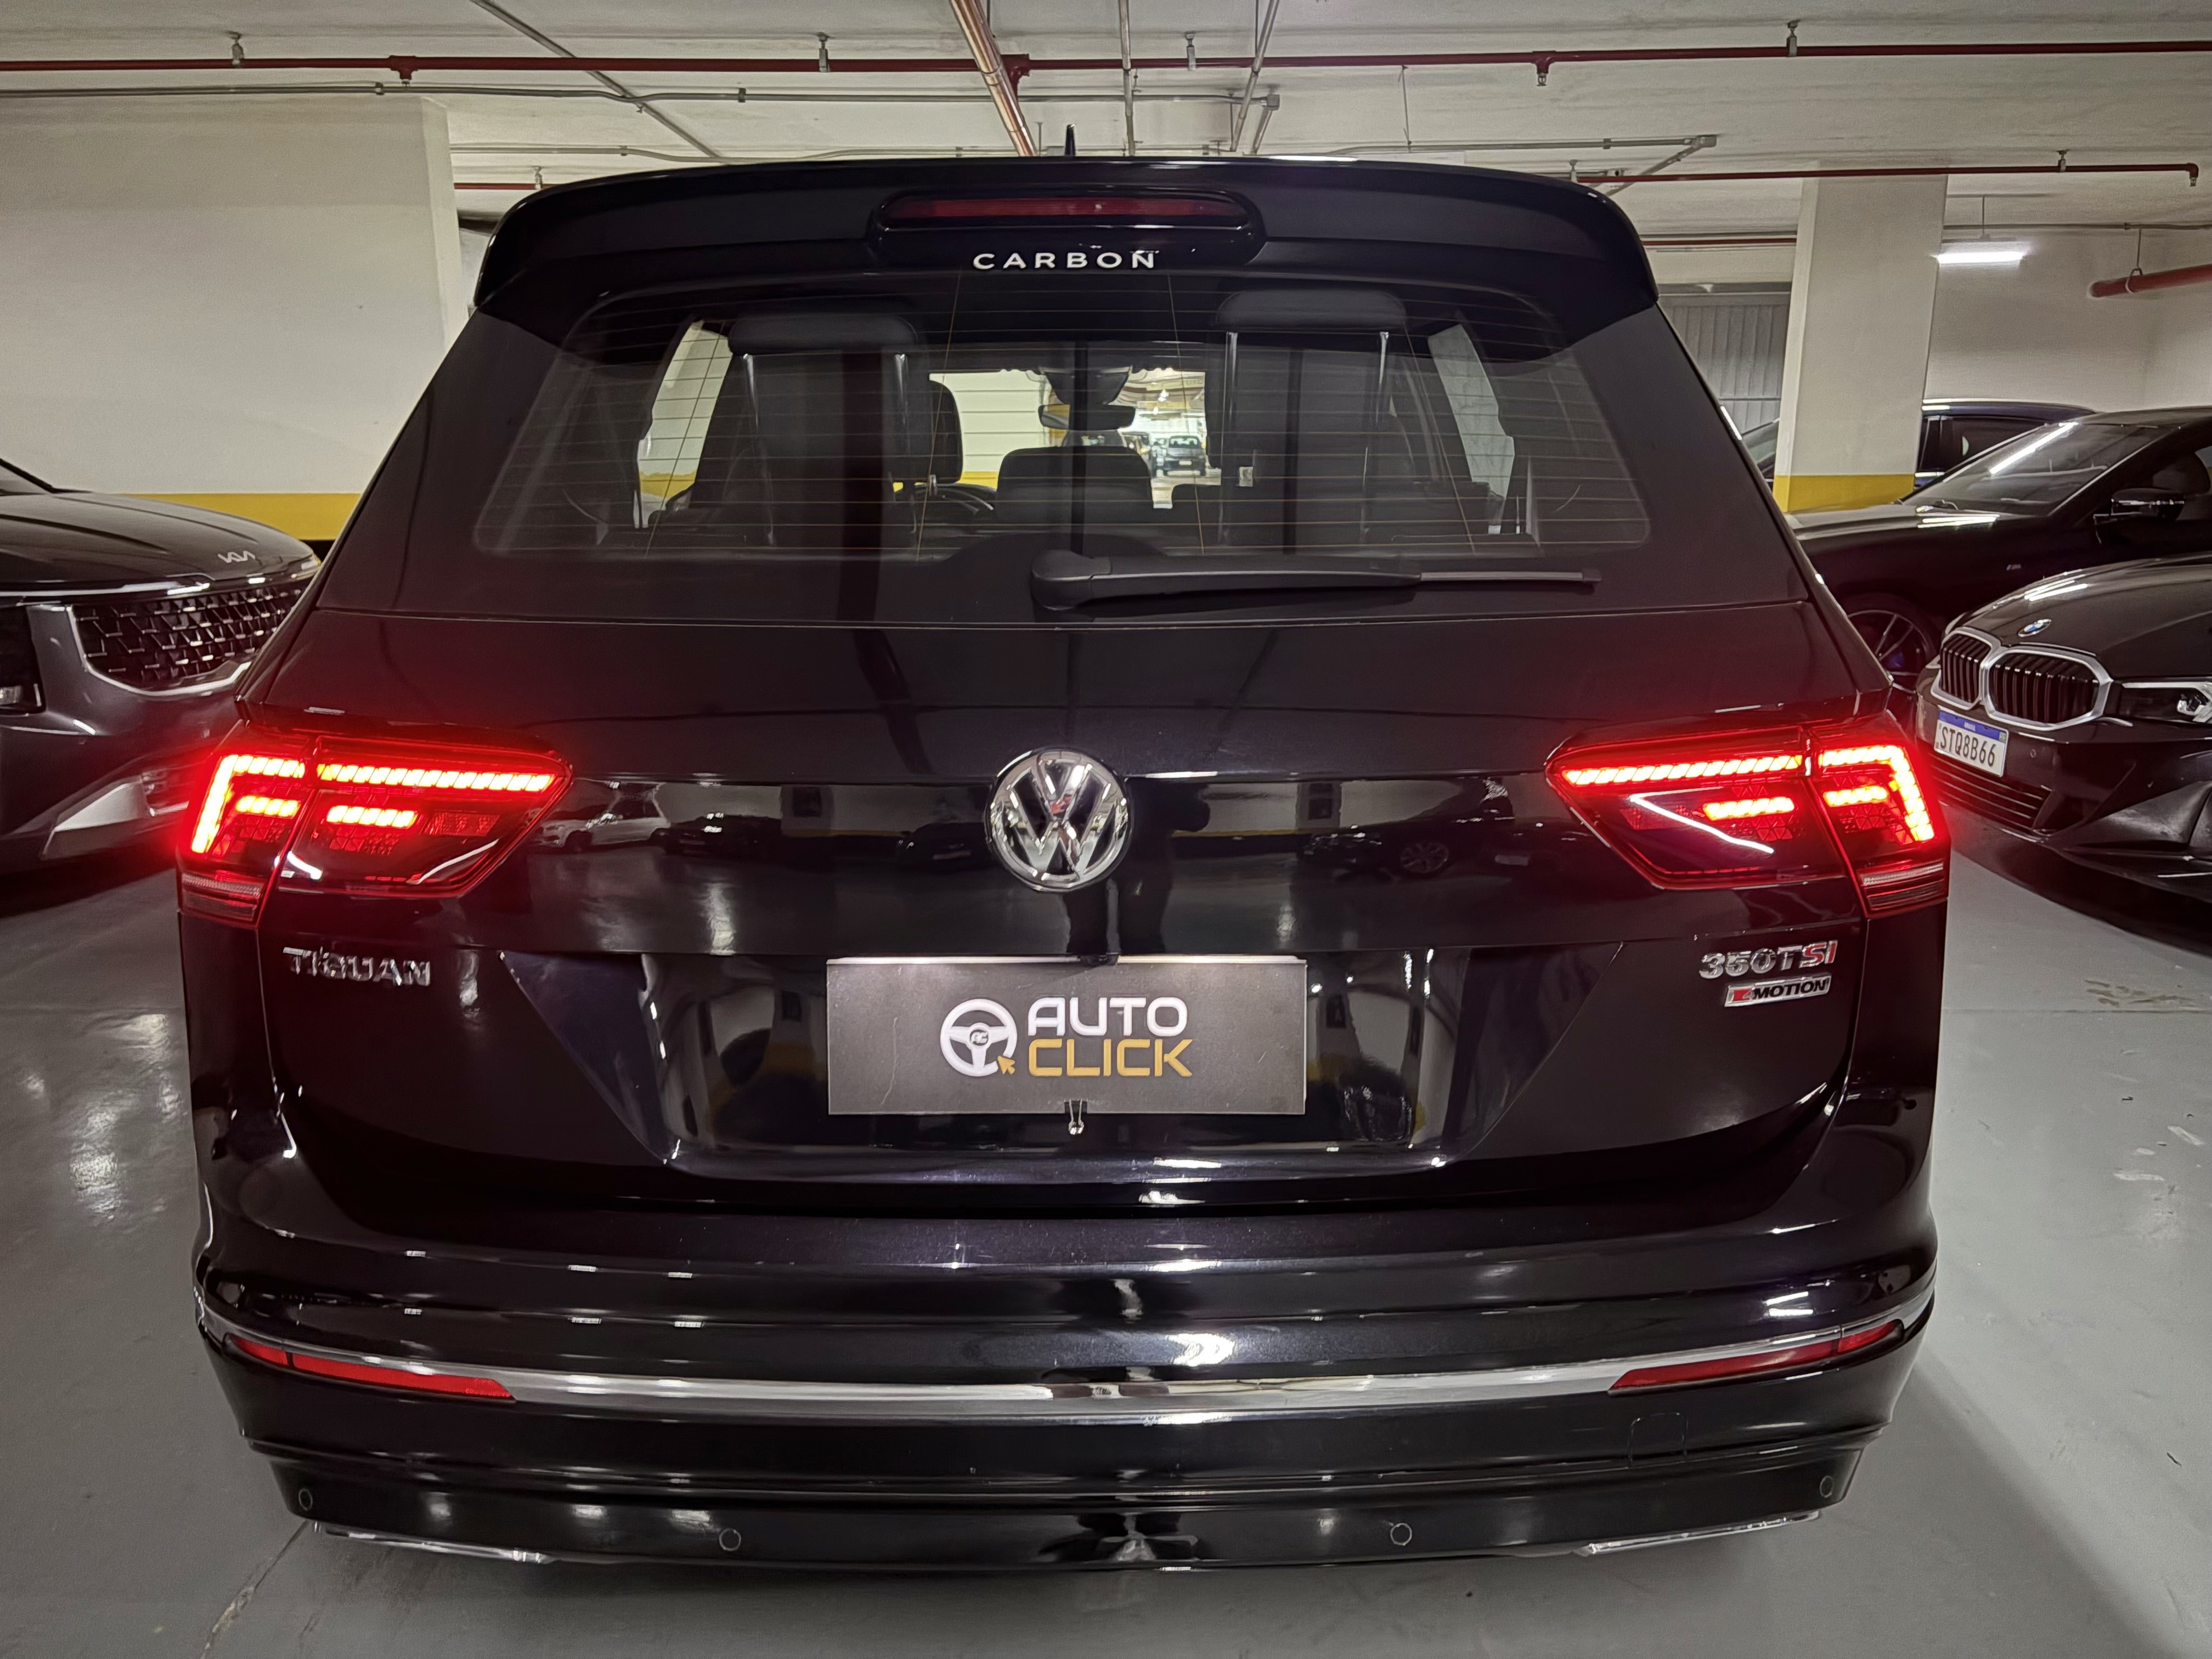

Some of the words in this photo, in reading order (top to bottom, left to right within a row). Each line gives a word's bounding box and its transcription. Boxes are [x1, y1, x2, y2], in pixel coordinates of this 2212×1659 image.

[973, 252, 1154, 269] CARBON
[1940, 726, 1996, 767] STQ8B66
[1028, 997, 1187, 1036] AUTO
[1029, 1039, 1192, 1077] CLICK
